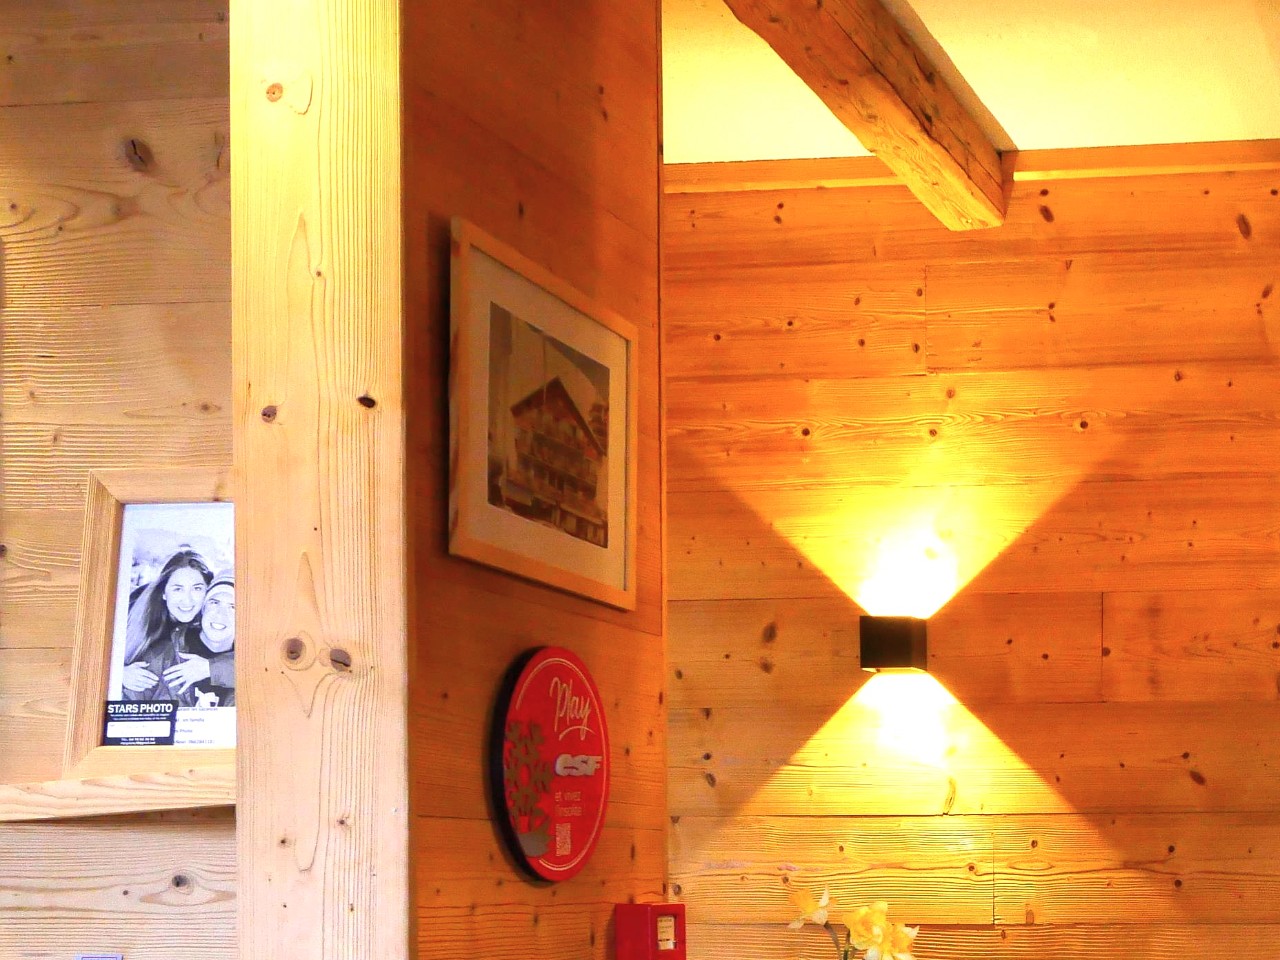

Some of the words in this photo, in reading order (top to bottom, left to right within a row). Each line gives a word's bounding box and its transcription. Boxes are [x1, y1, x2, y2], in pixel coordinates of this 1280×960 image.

[107, 704, 139, 713] STARS
[139, 703, 173, 713] PHOTO
[550, 677, 592, 741] Play
